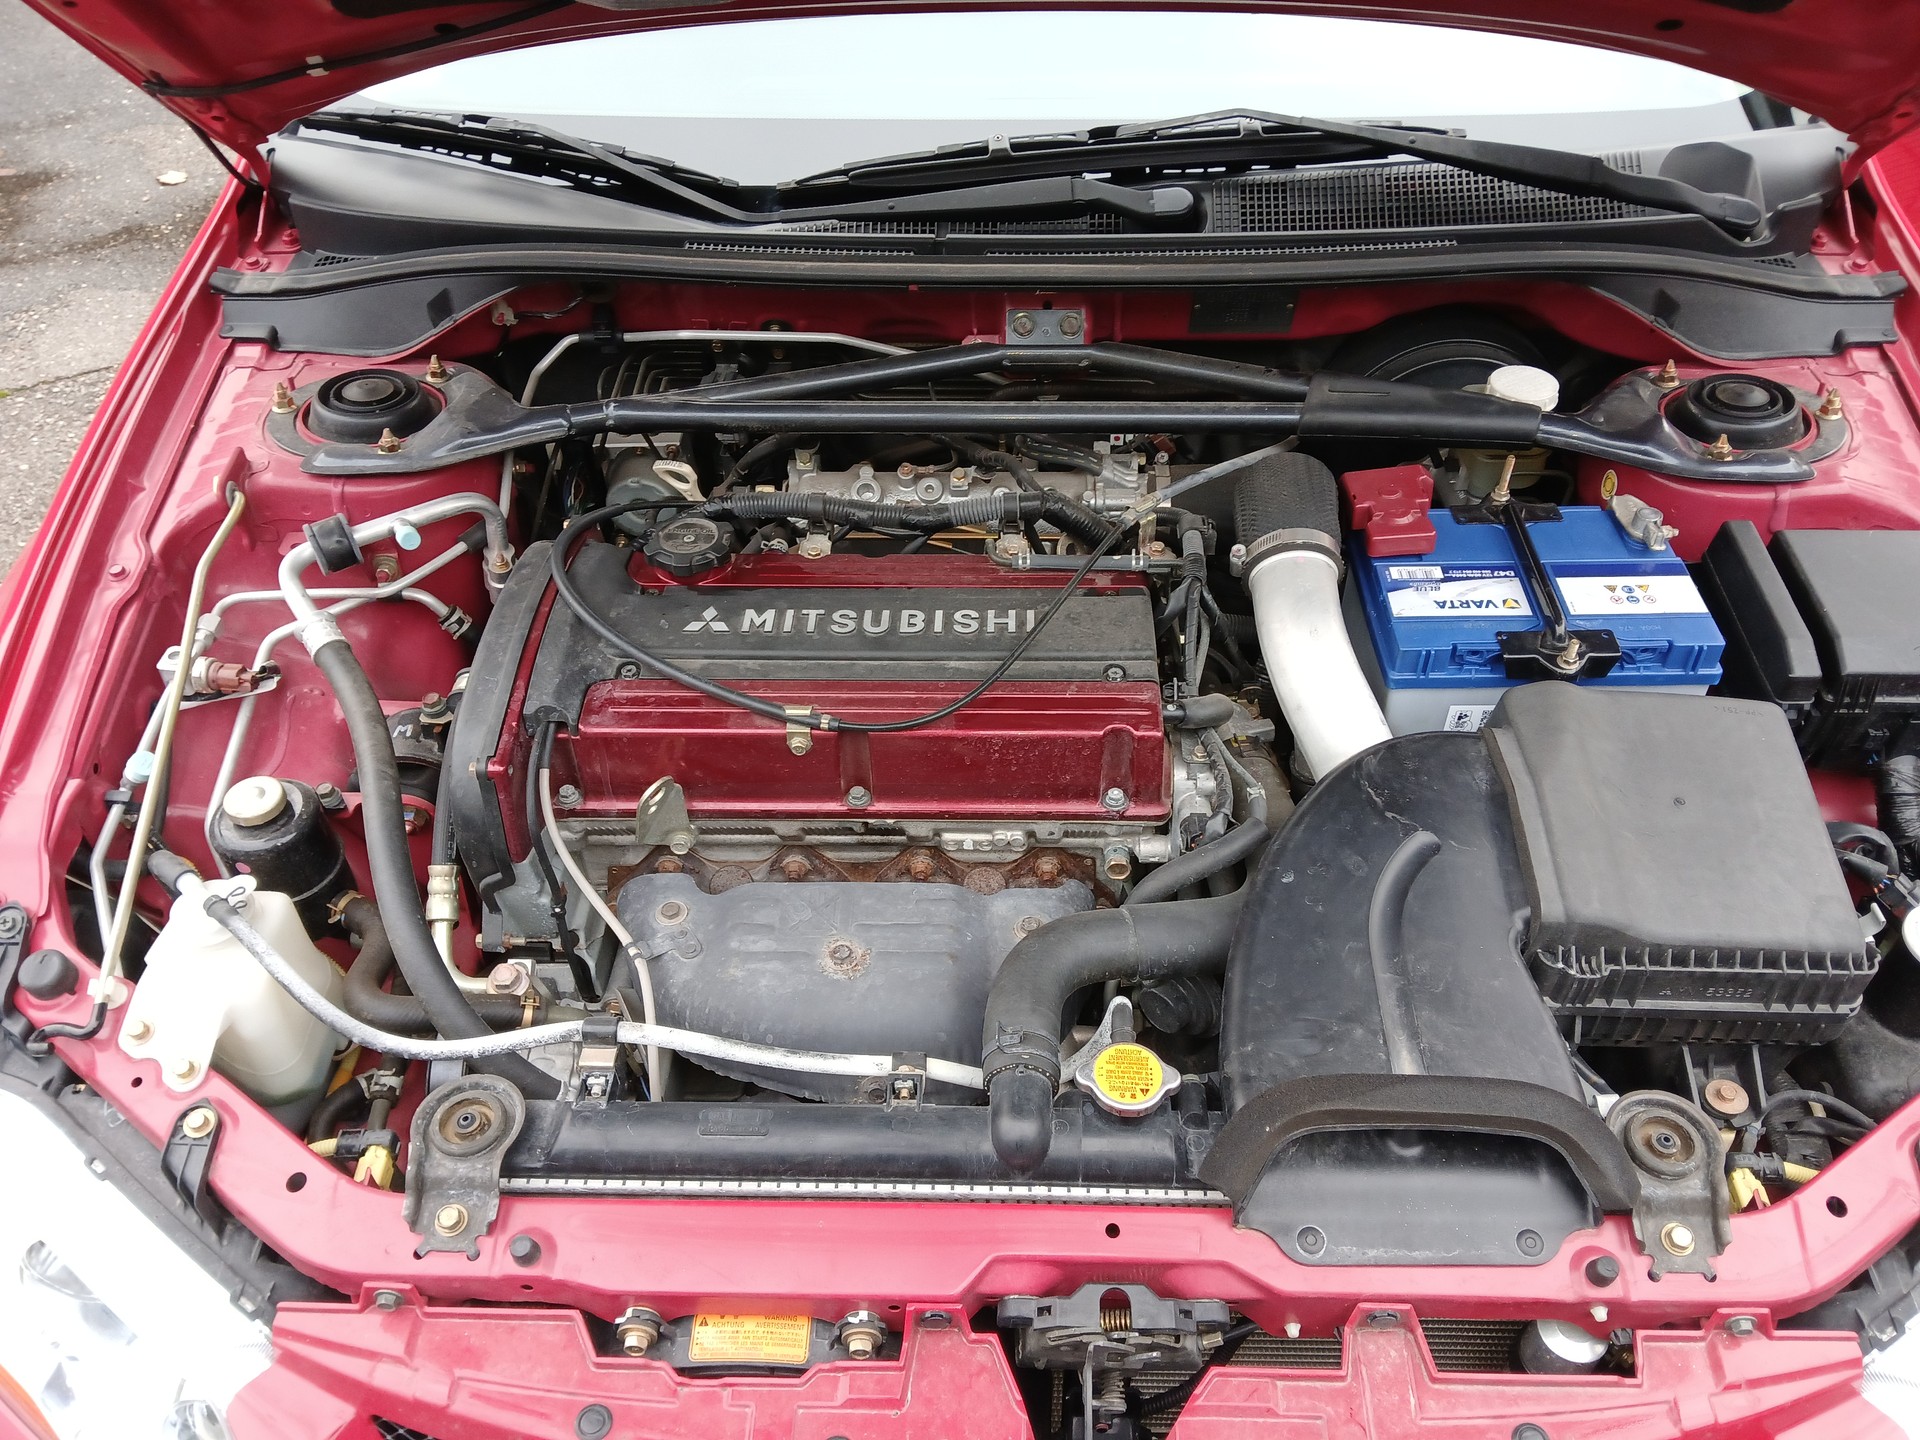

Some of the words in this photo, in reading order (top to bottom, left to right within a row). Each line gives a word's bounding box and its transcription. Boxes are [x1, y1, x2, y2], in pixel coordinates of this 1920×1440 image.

[1433, 600, 1499, 609] VARTA
[740, 608, 1040, 634] MITSUBISHI
[1108, 1054, 1150, 1062] AVERTISSEMENT
[755, 1322, 805, 1330] AVERTISSEMENT
